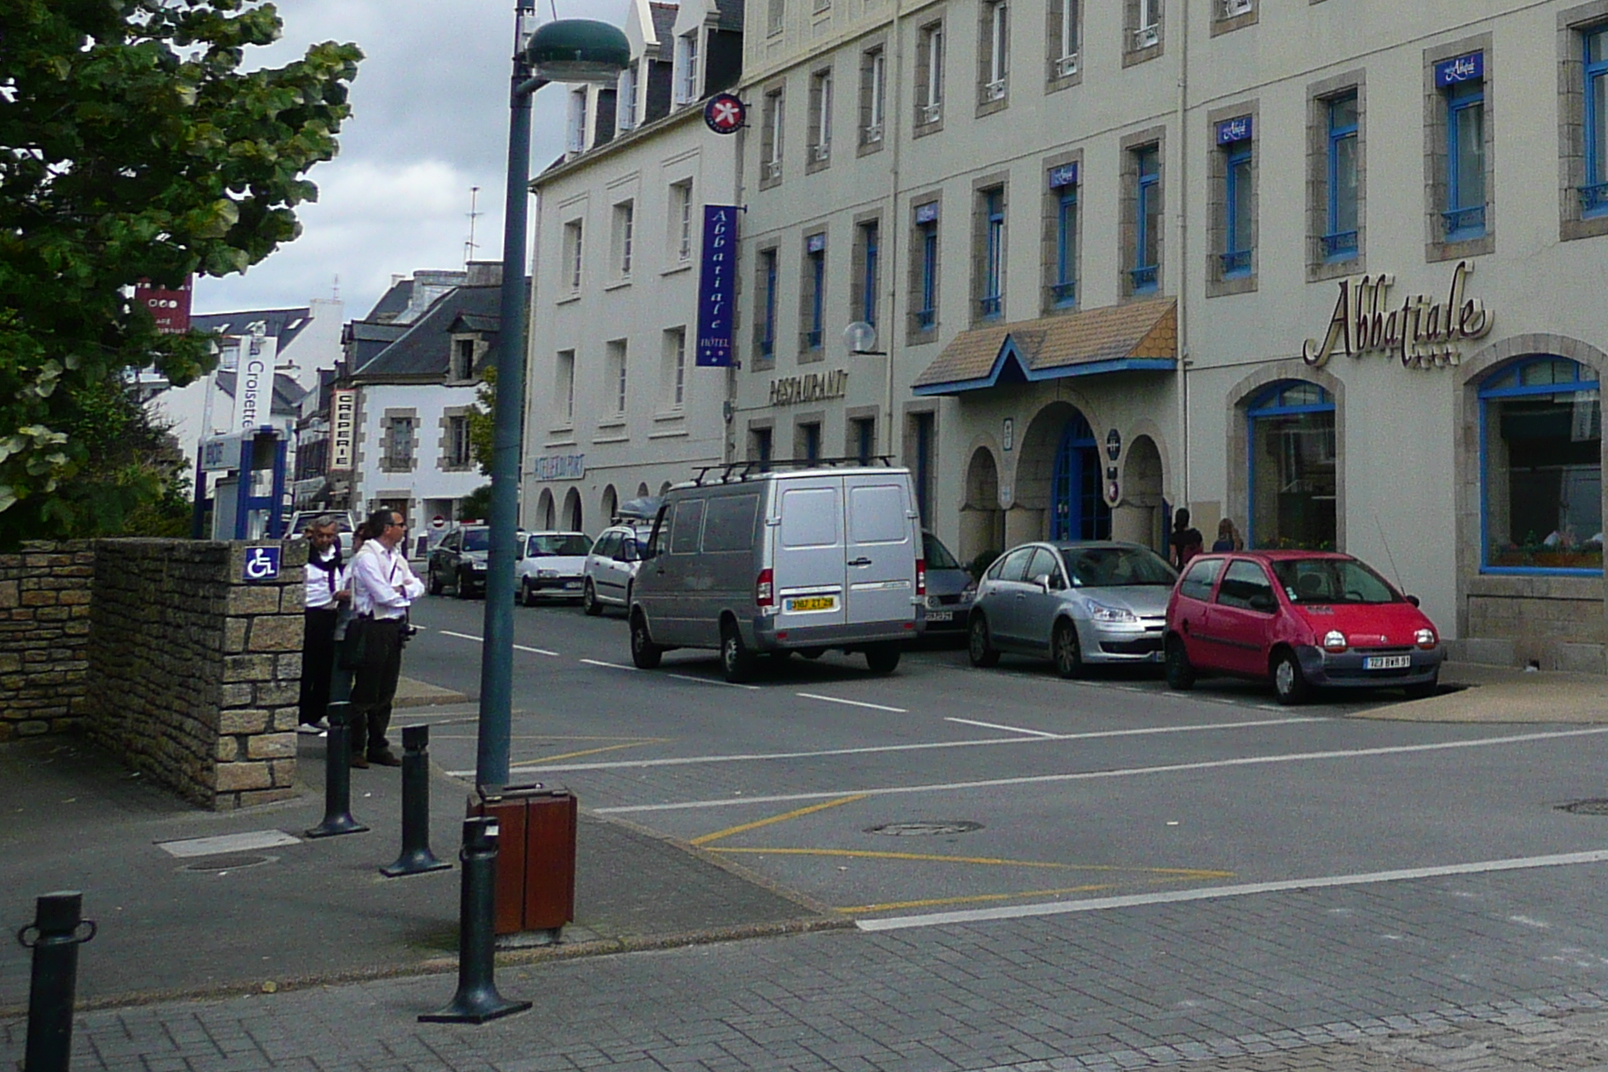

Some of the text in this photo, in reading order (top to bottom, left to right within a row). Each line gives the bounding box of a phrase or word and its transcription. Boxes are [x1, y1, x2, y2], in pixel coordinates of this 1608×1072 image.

[711, 210, 728, 329] Abbatiale
[1302, 260, 1488, 369] Abbatiale
[242, 360, 265, 428] Croisette
[335, 395, 353, 465] CREPERIE
